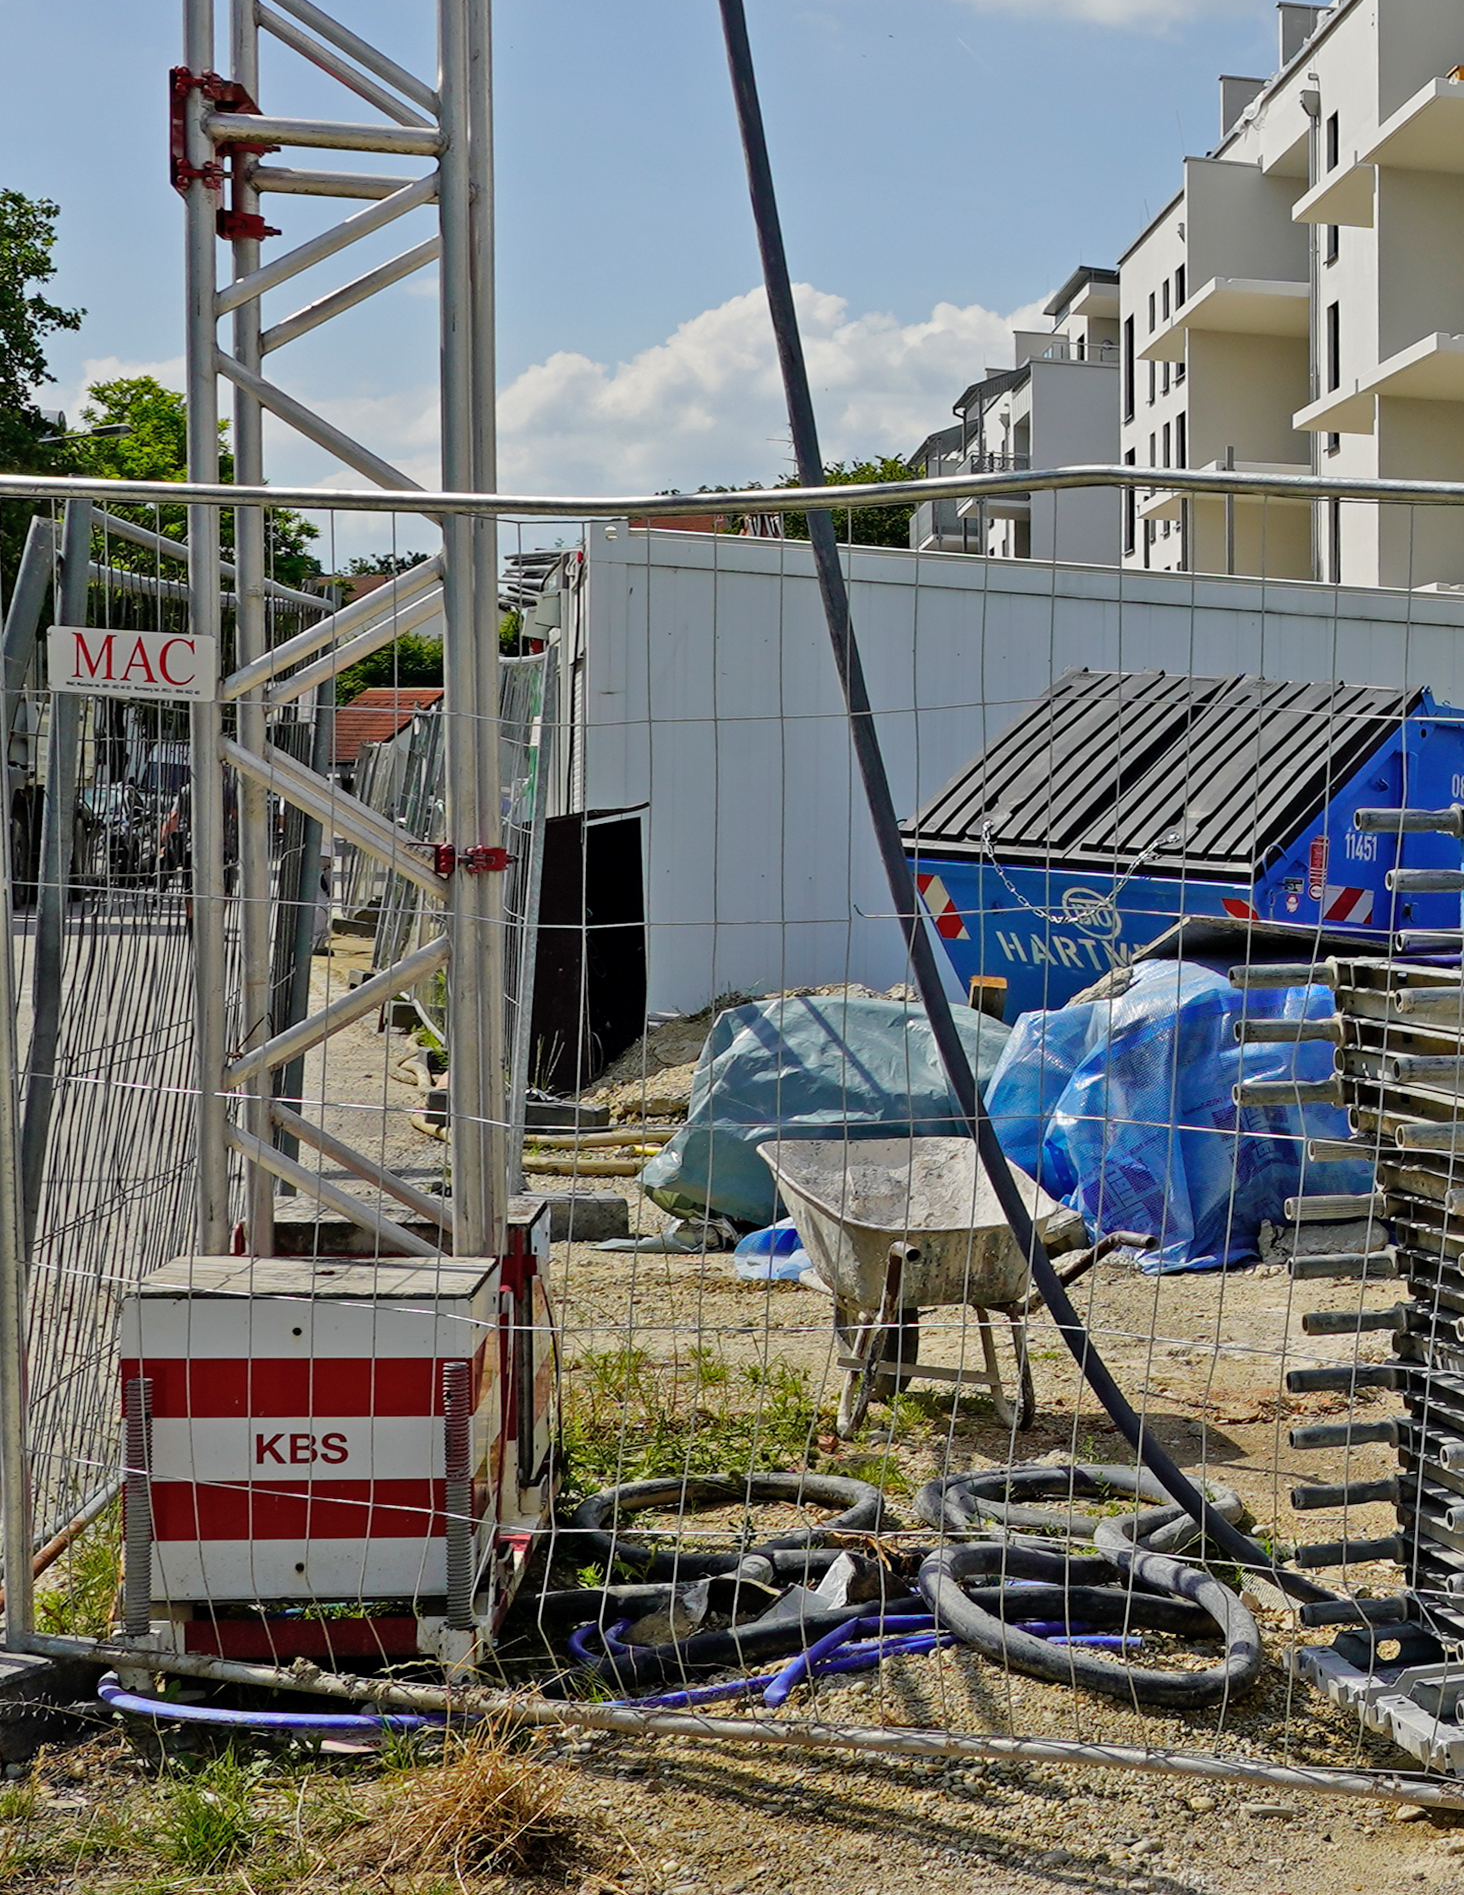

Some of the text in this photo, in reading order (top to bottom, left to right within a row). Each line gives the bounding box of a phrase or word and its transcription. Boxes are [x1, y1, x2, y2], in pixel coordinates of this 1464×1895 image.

[71, 632, 196, 686] MAC
[1345, 832, 1378, 862] 11451
[255, 1432, 349, 1465] KBS
